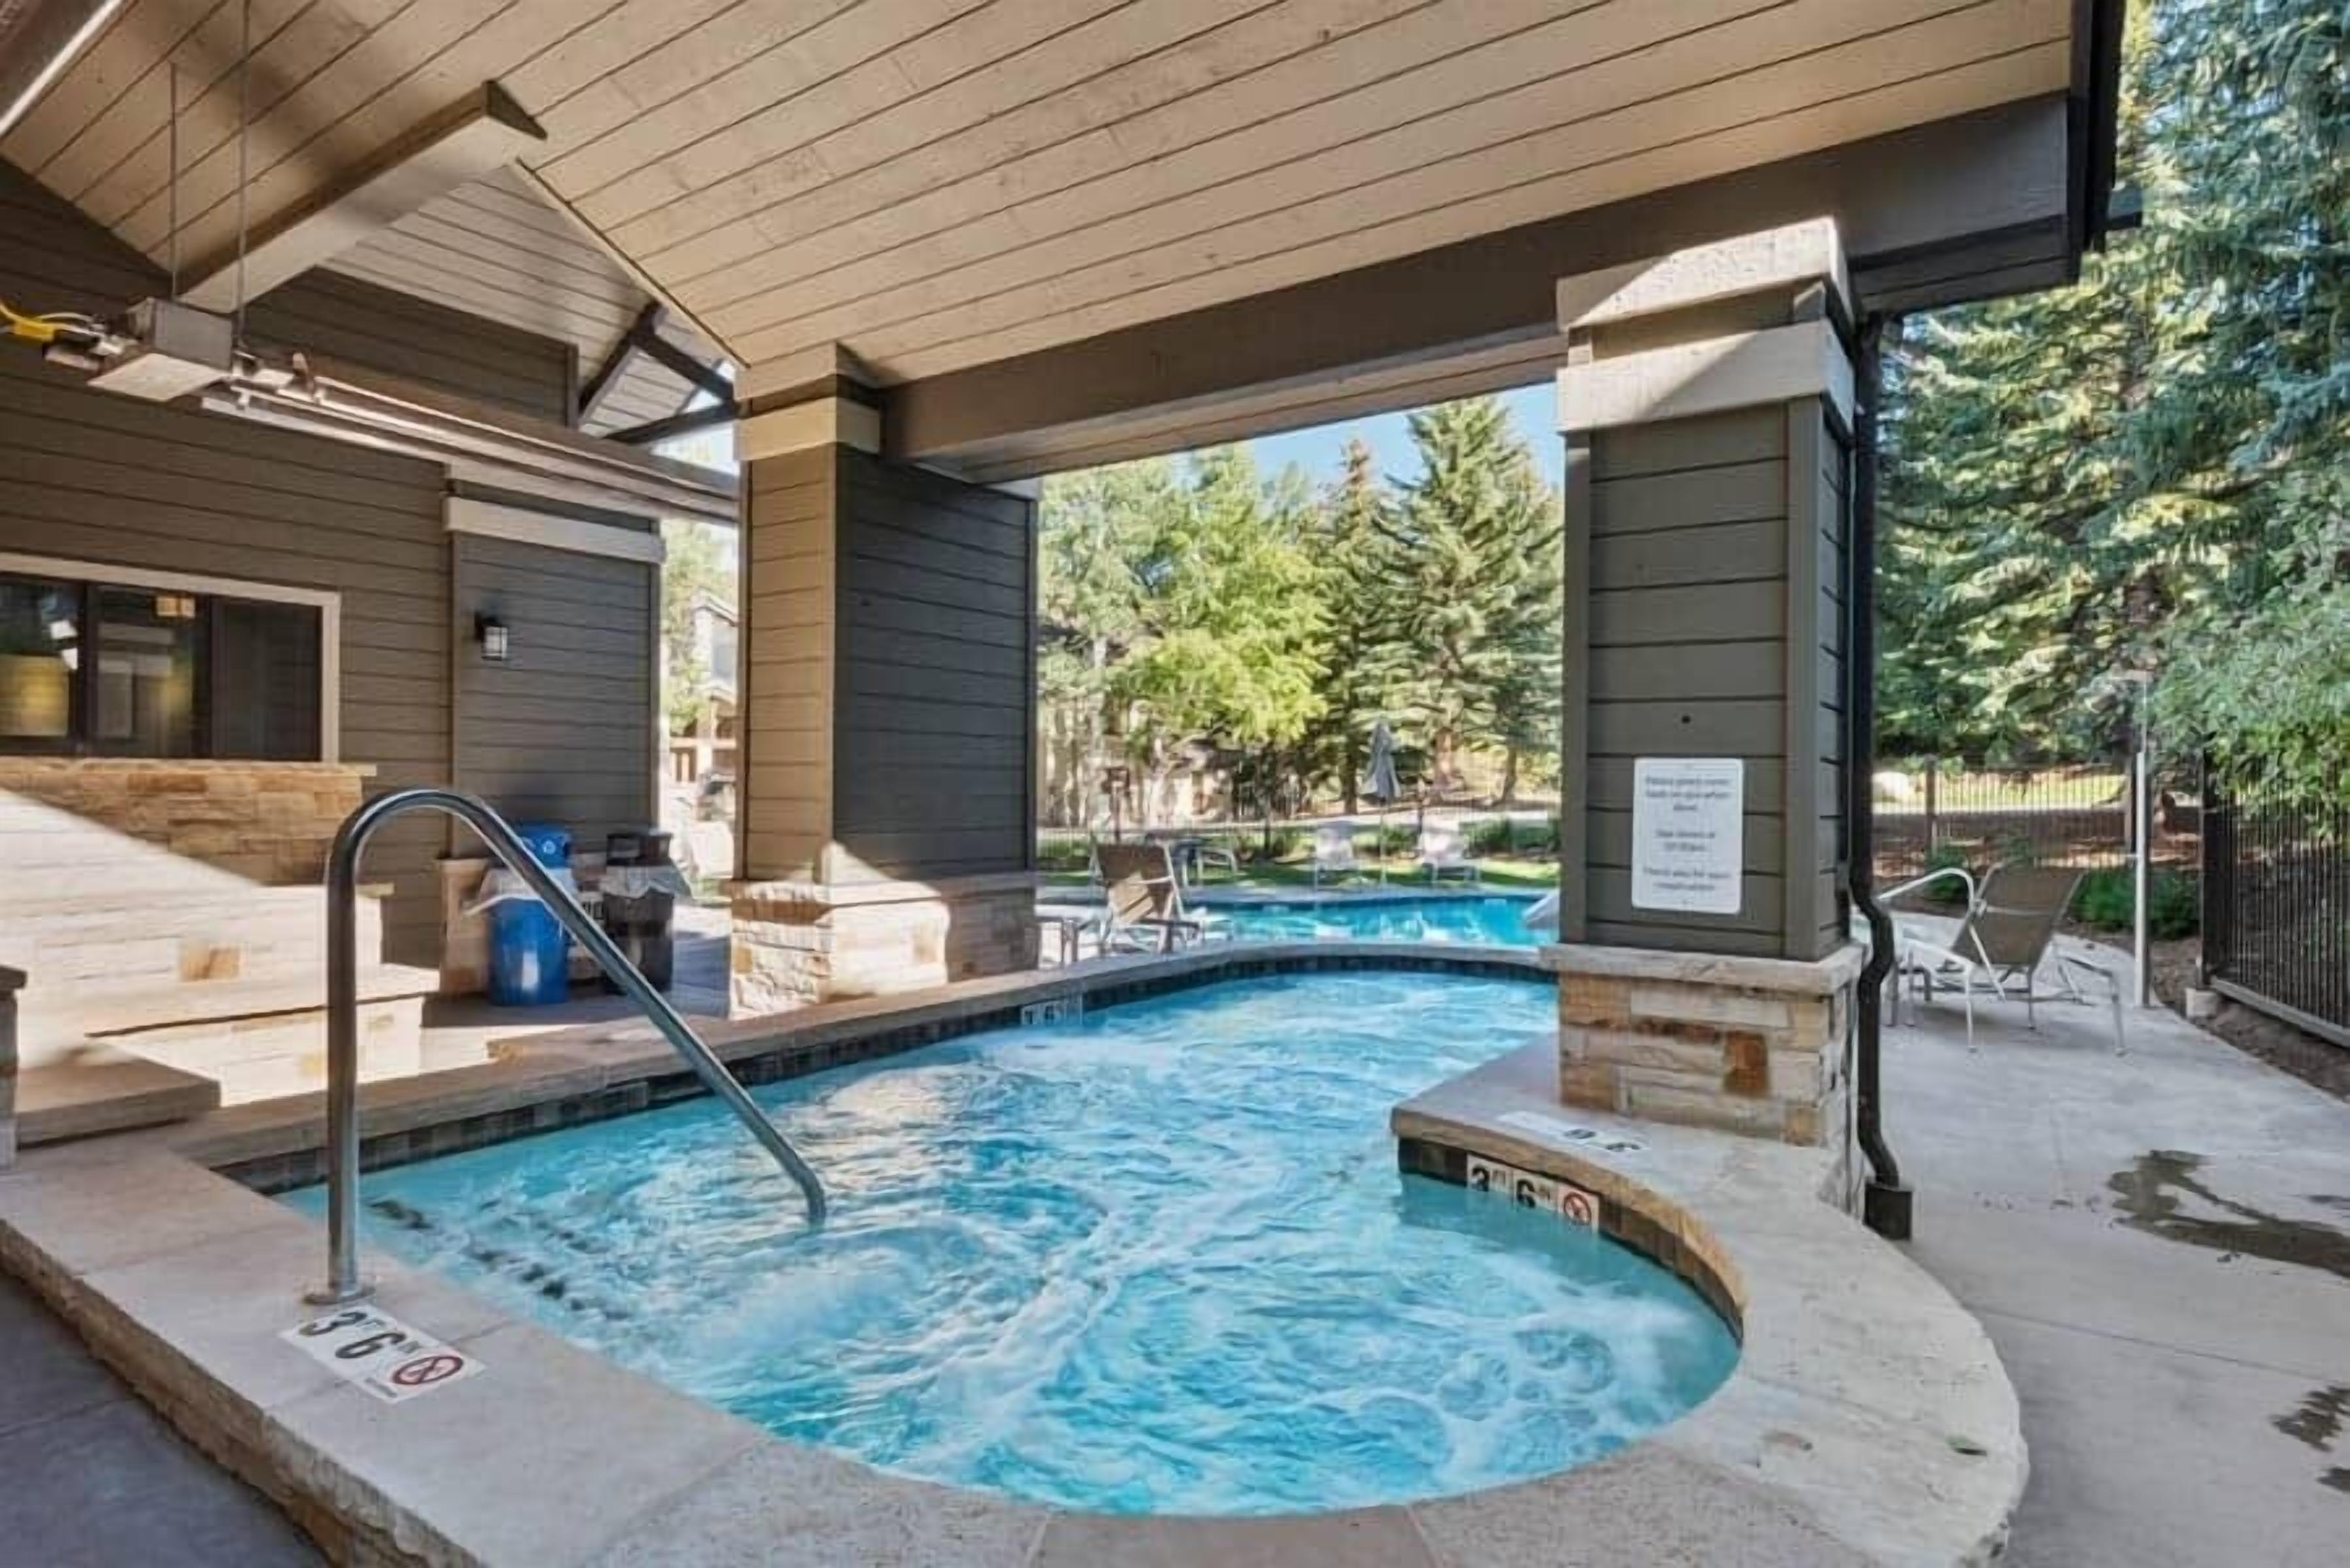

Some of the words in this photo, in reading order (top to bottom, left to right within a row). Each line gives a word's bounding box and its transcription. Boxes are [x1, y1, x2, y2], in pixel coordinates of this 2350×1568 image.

[1471, 1164, 1489, 1192] 3
[1516, 1179, 1536, 1209] 6
[298, 1311, 368, 1337] 3
[335, 1332, 406, 1359] 6
